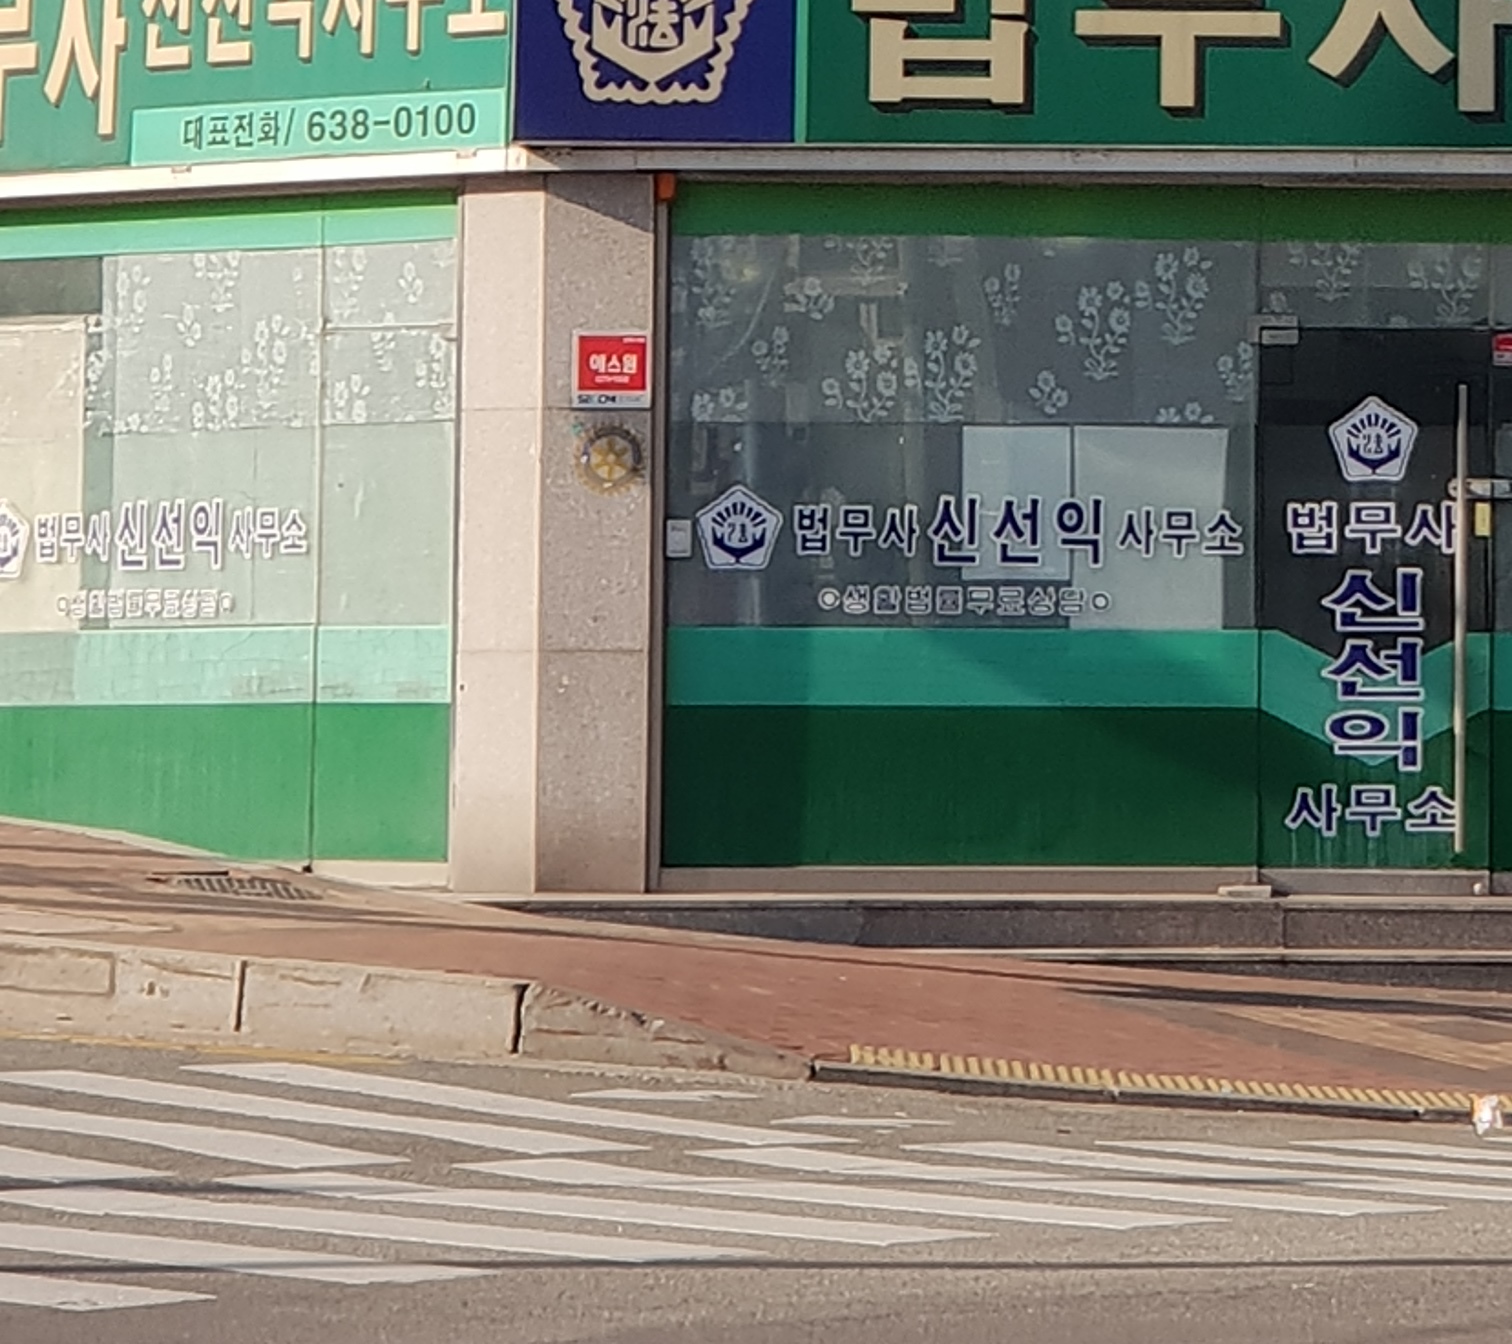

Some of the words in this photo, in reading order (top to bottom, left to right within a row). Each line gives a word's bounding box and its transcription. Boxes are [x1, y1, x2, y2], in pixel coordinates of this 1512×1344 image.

[307, 103, 476, 142] 638-0100
[34, 511, 110, 565] 법무사
[114, 497, 224, 571] 신선익
[228, 506, 308, 559] 사무소
[792, 503, 919, 558] 법무사
[928, 494, 1103, 567] 신선익
[1117, 507, 1245, 558] 사무소
[1286, 500, 1457, 555] 법무사
[1321, 566, 1426, 773] 신선익
[1285, 784, 1458, 838] 사무소
